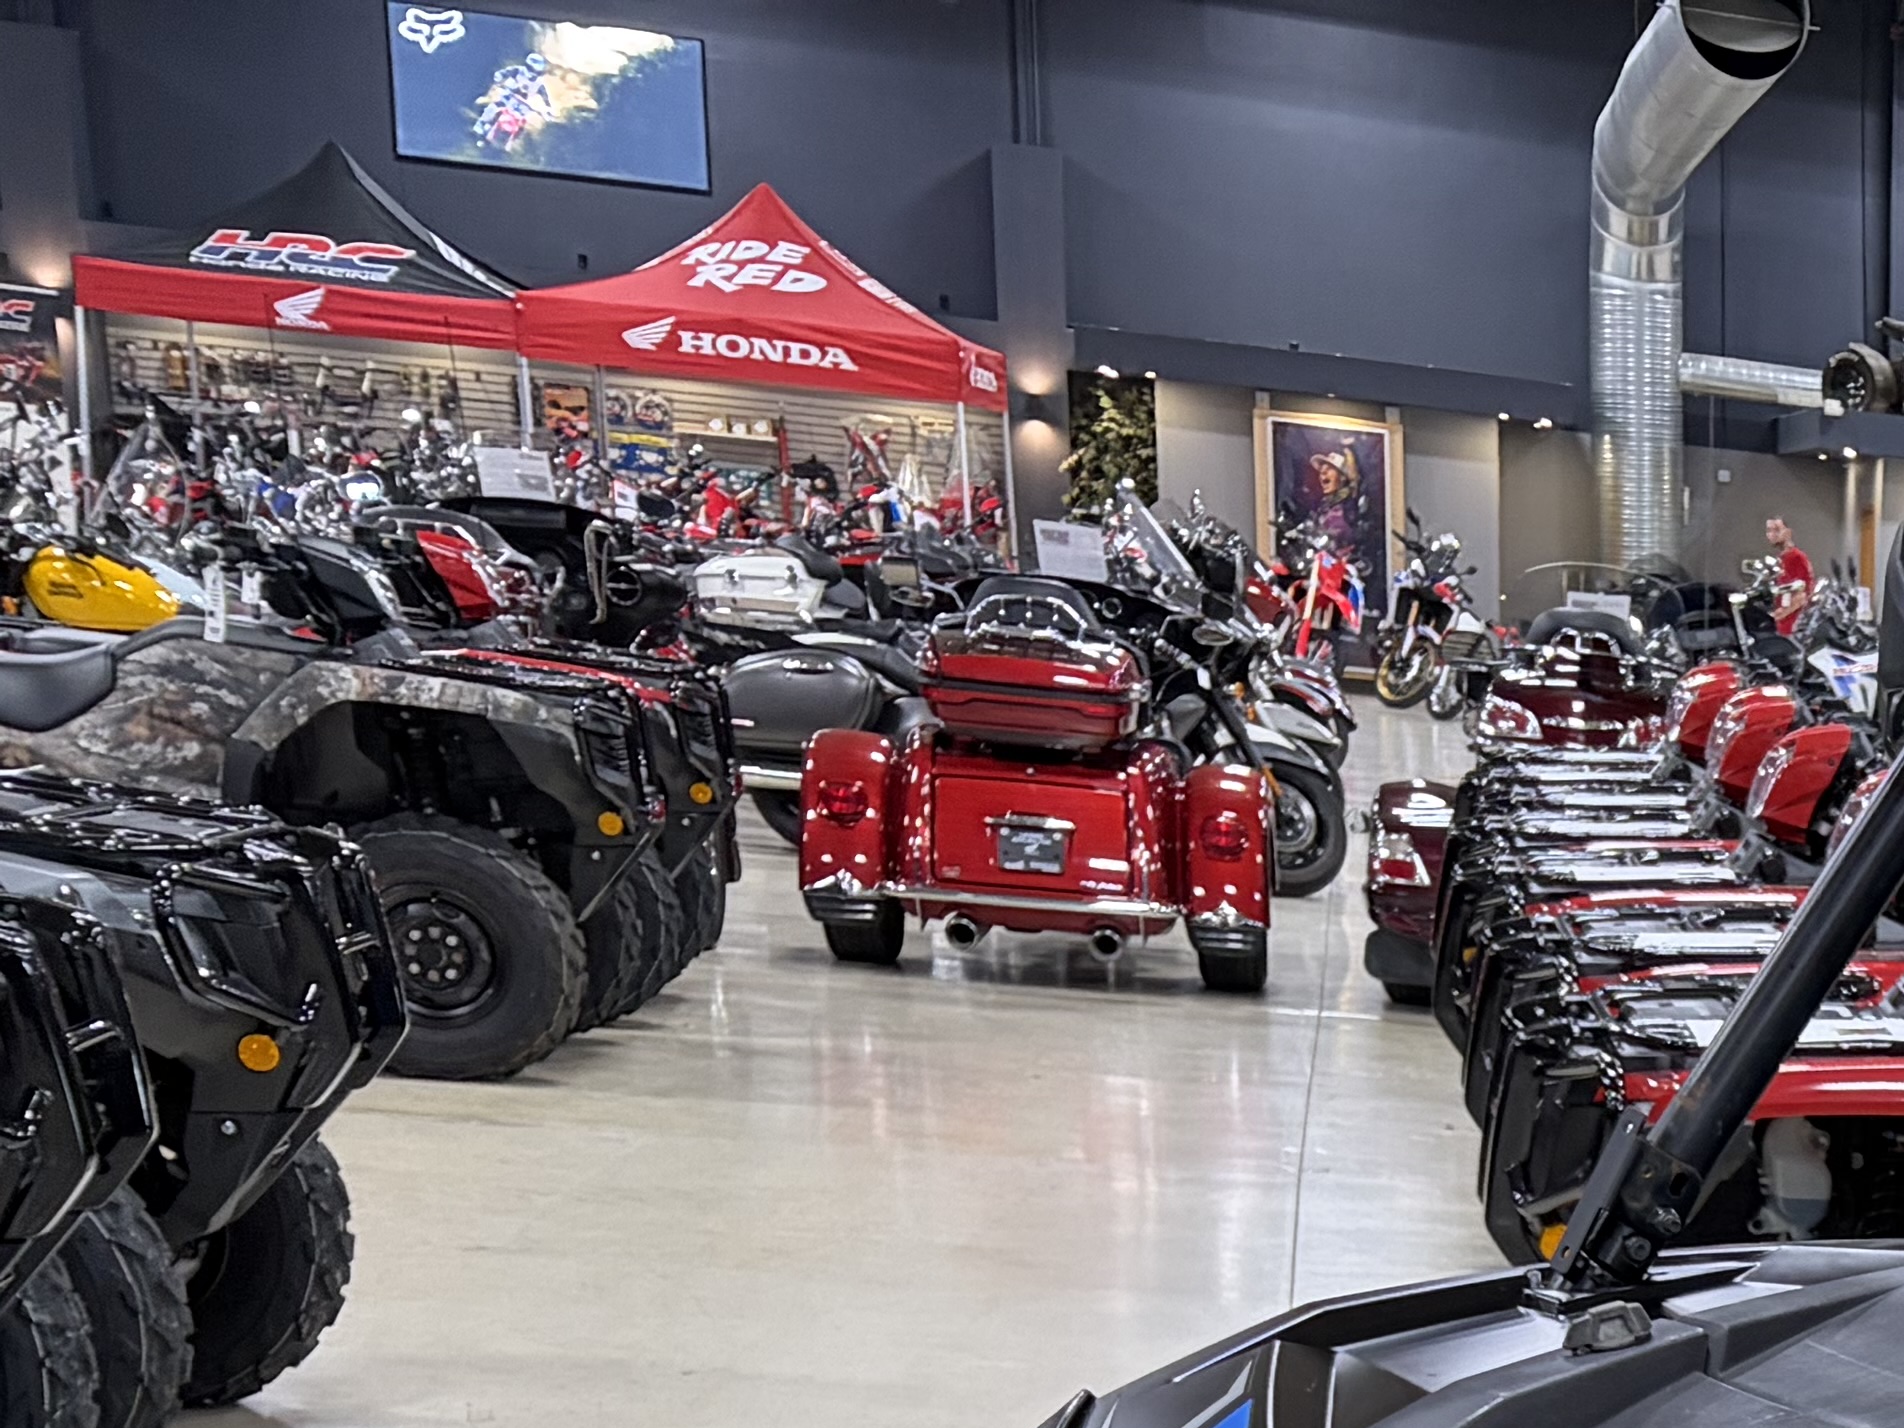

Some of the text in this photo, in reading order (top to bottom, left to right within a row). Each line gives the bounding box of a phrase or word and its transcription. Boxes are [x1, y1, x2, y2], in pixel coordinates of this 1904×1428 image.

[190, 229, 416, 276] HRC
[680, 240, 811, 265] RIDE
[686, 263, 828, 293] RED
[677, 330, 860, 372] HONDA
